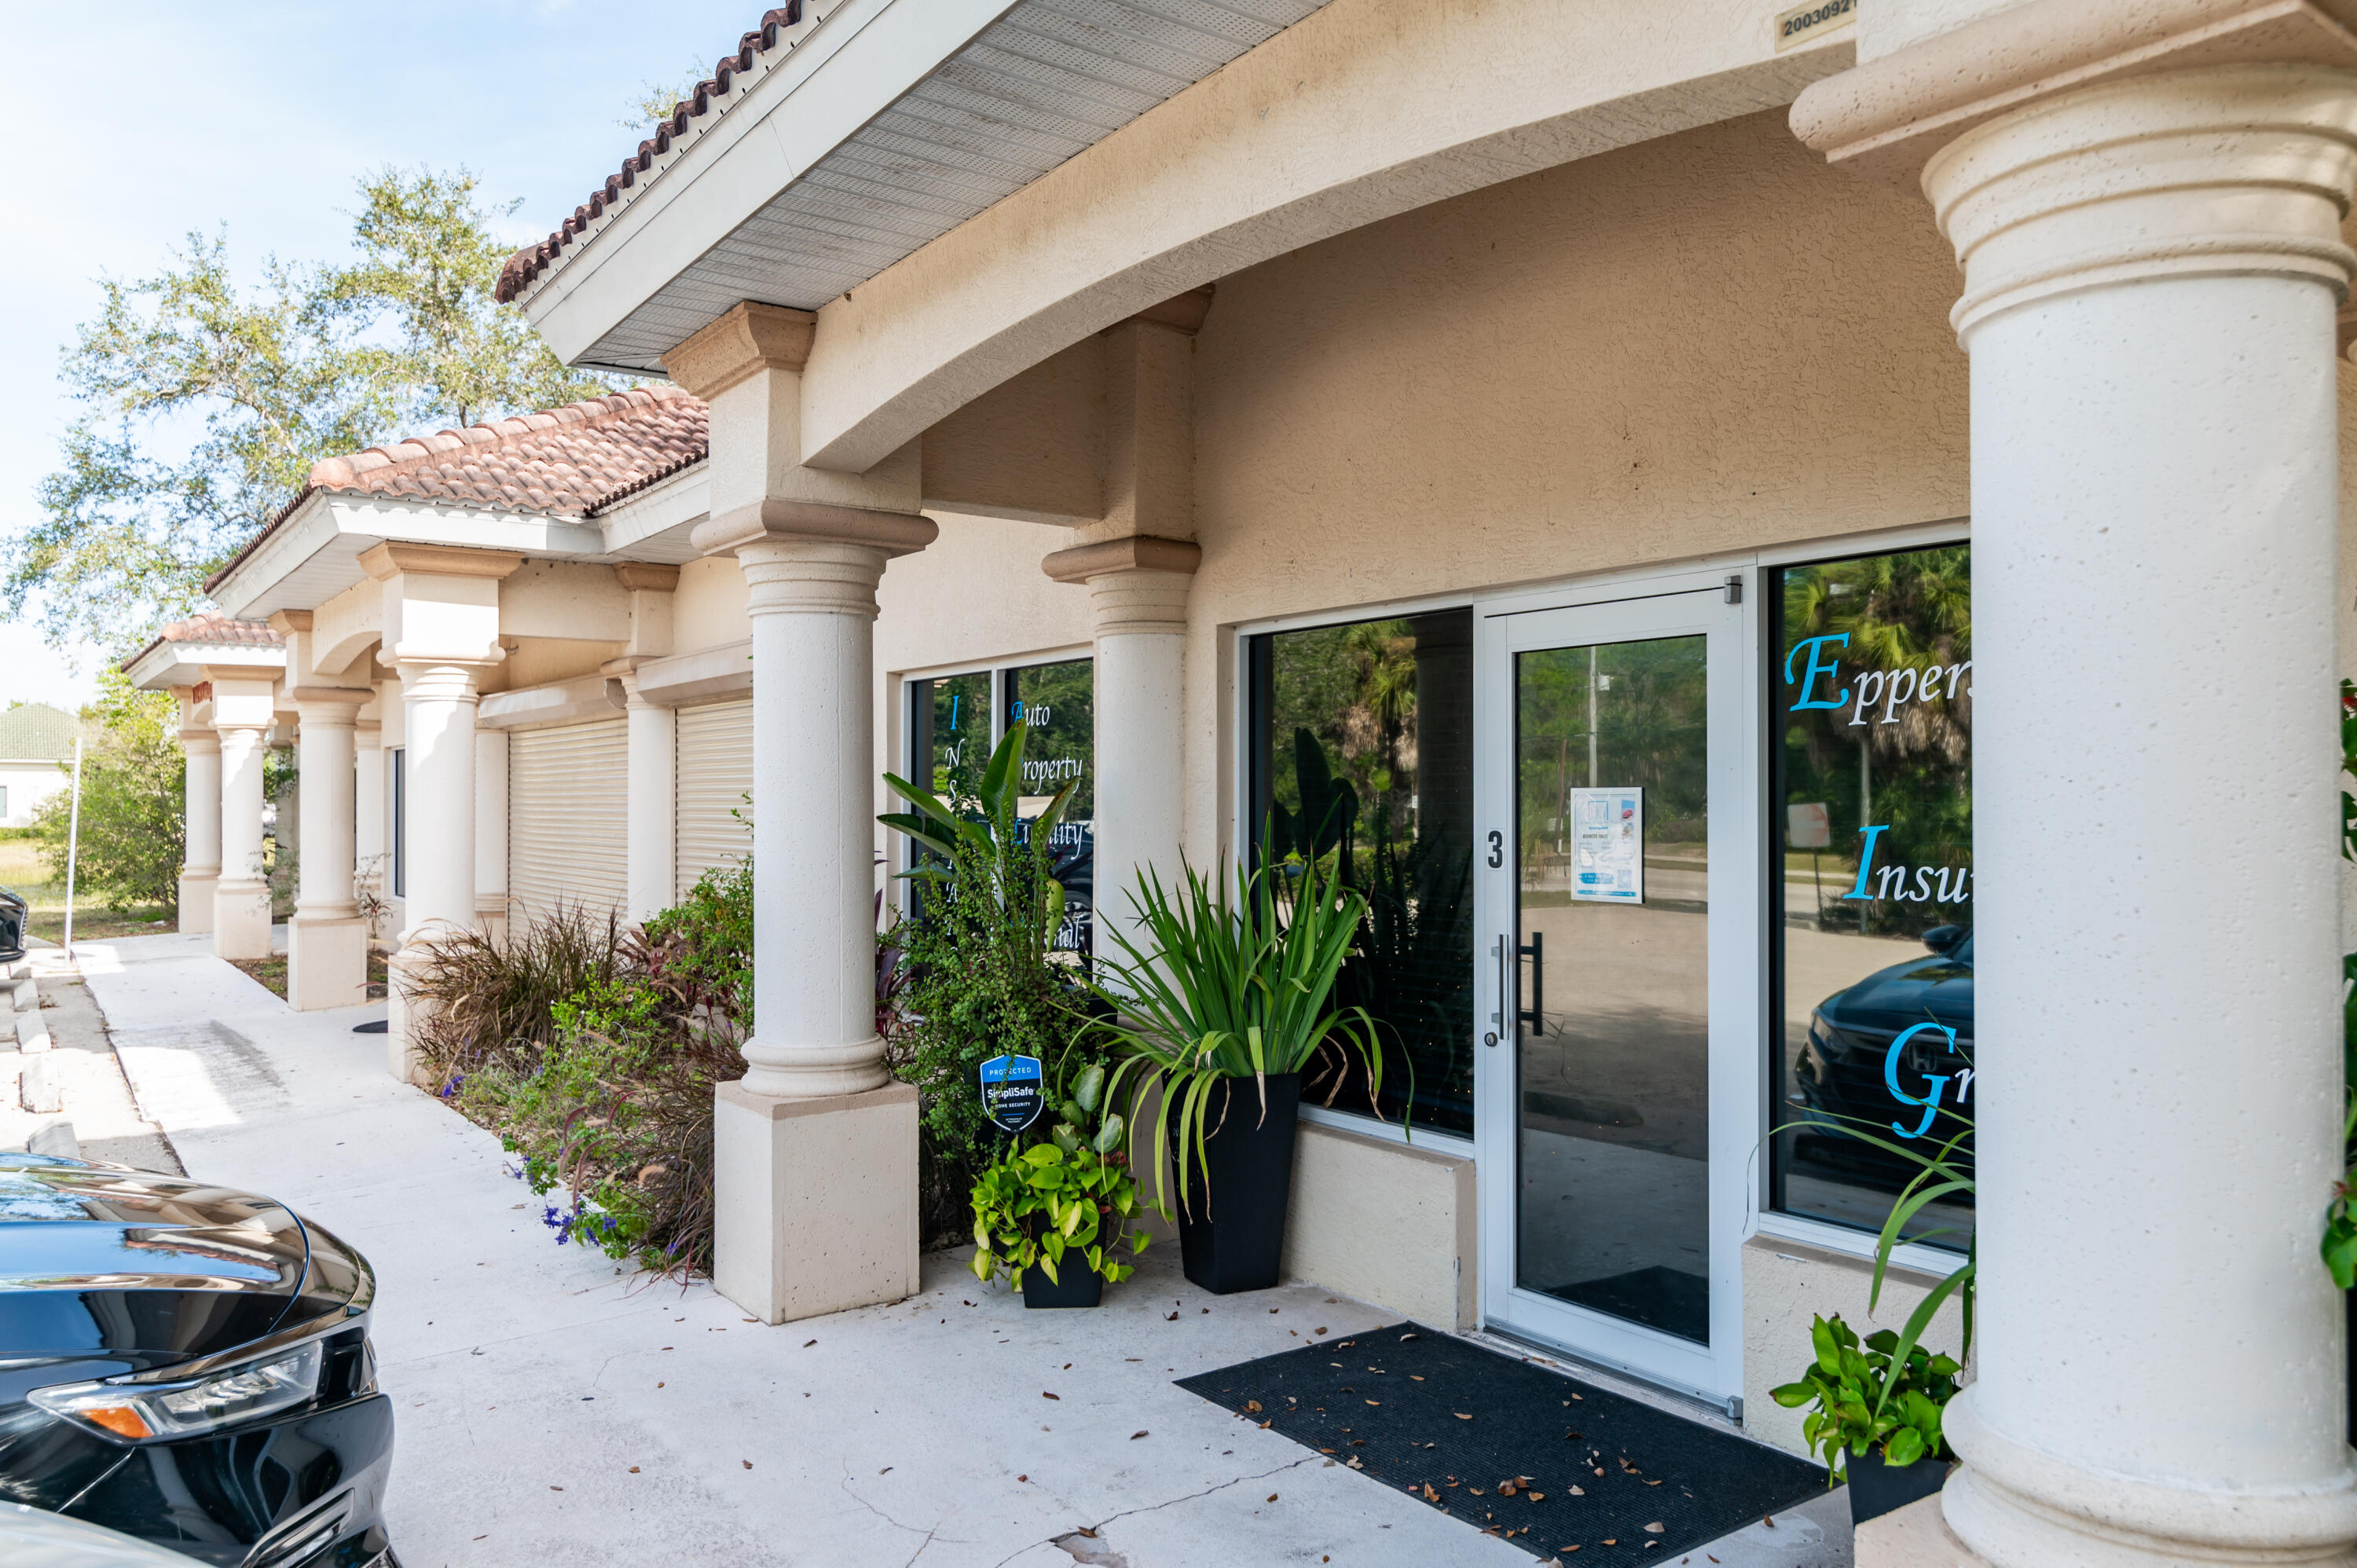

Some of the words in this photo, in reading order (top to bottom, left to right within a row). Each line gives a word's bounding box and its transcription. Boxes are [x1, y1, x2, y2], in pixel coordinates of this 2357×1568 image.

[1784, 632, 1973, 726] Epper
[1012, 701, 1050, 727] Auto
[1021, 756, 1083, 795] roperty
[1488, 830, 1503, 869] 3
[1842, 824, 1974, 903] Insu
